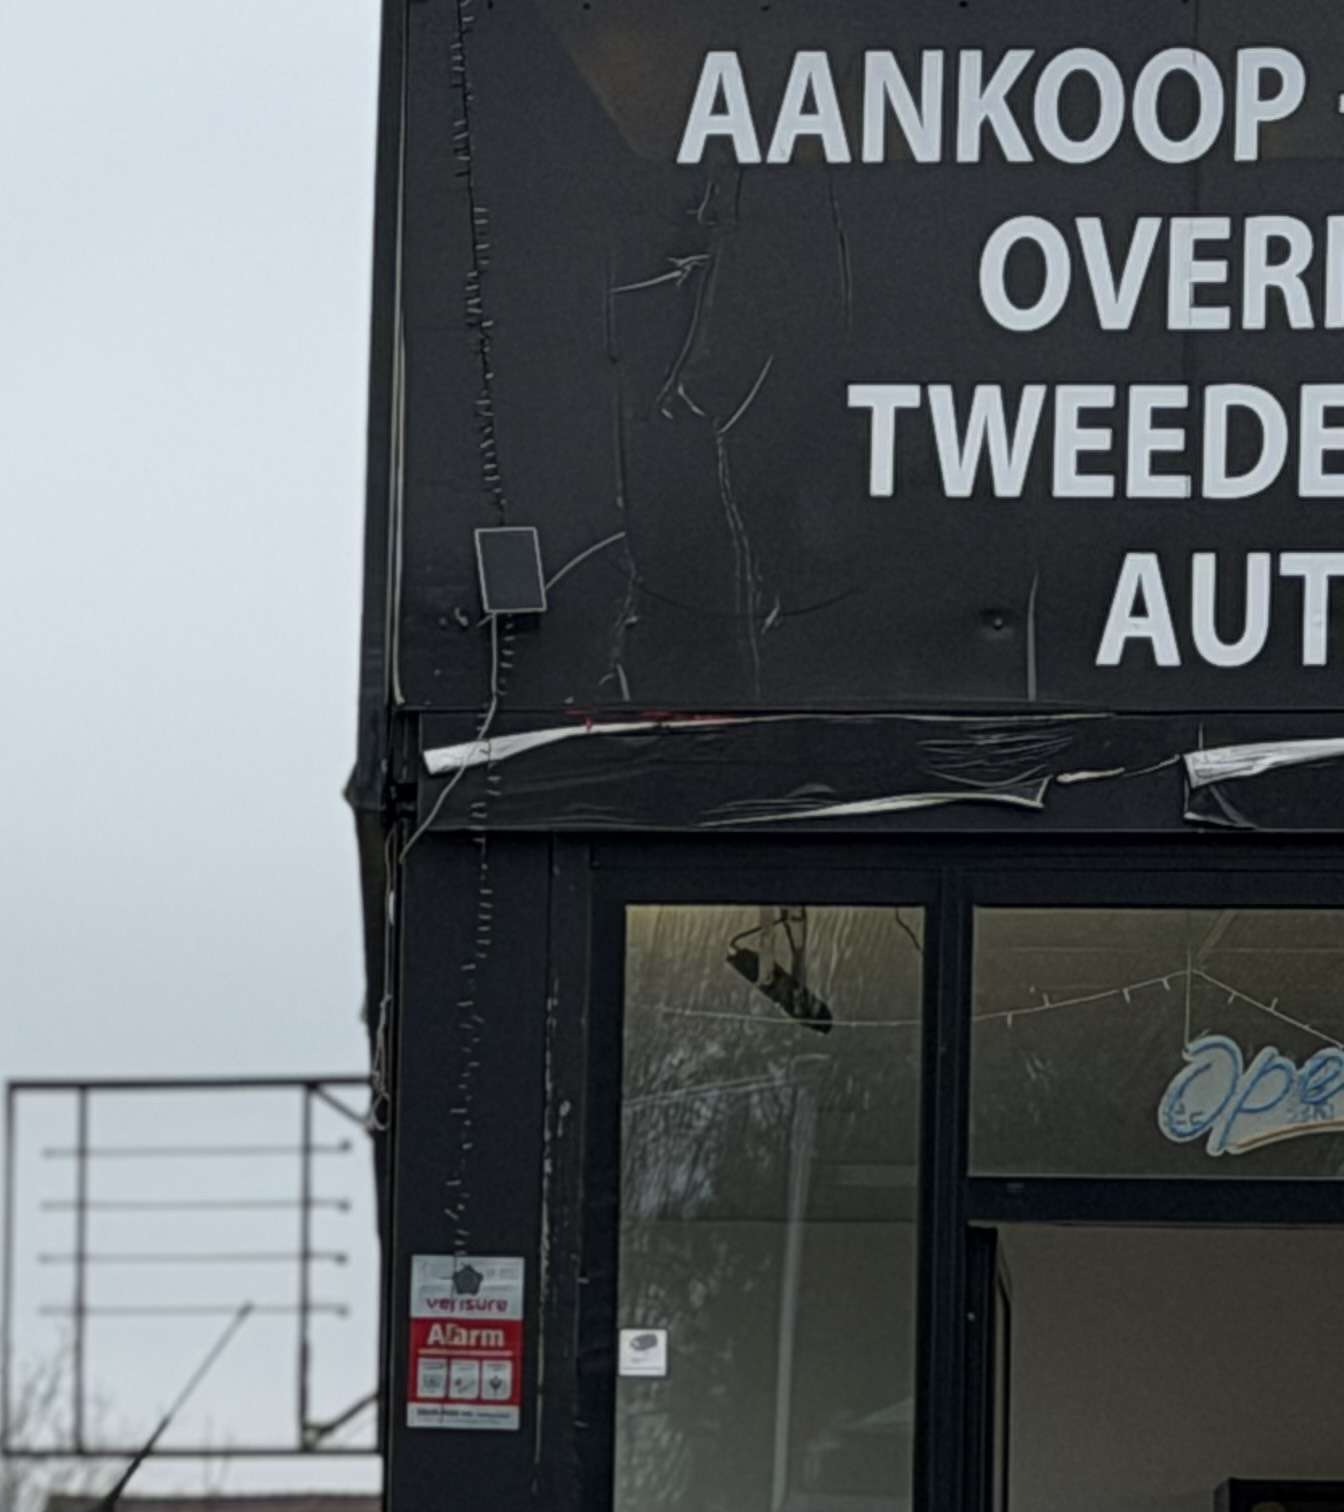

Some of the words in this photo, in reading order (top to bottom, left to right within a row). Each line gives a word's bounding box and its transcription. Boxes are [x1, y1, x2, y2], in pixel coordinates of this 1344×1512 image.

[677, 48, 1305, 163] AANKOOP
[980, 216, 1344, 331] OVER
[848, 384, 1344, 498] TWEEDE
[1096, 553, 1344, 666] AUT
[426, 1322, 504, 1347] Alarm
